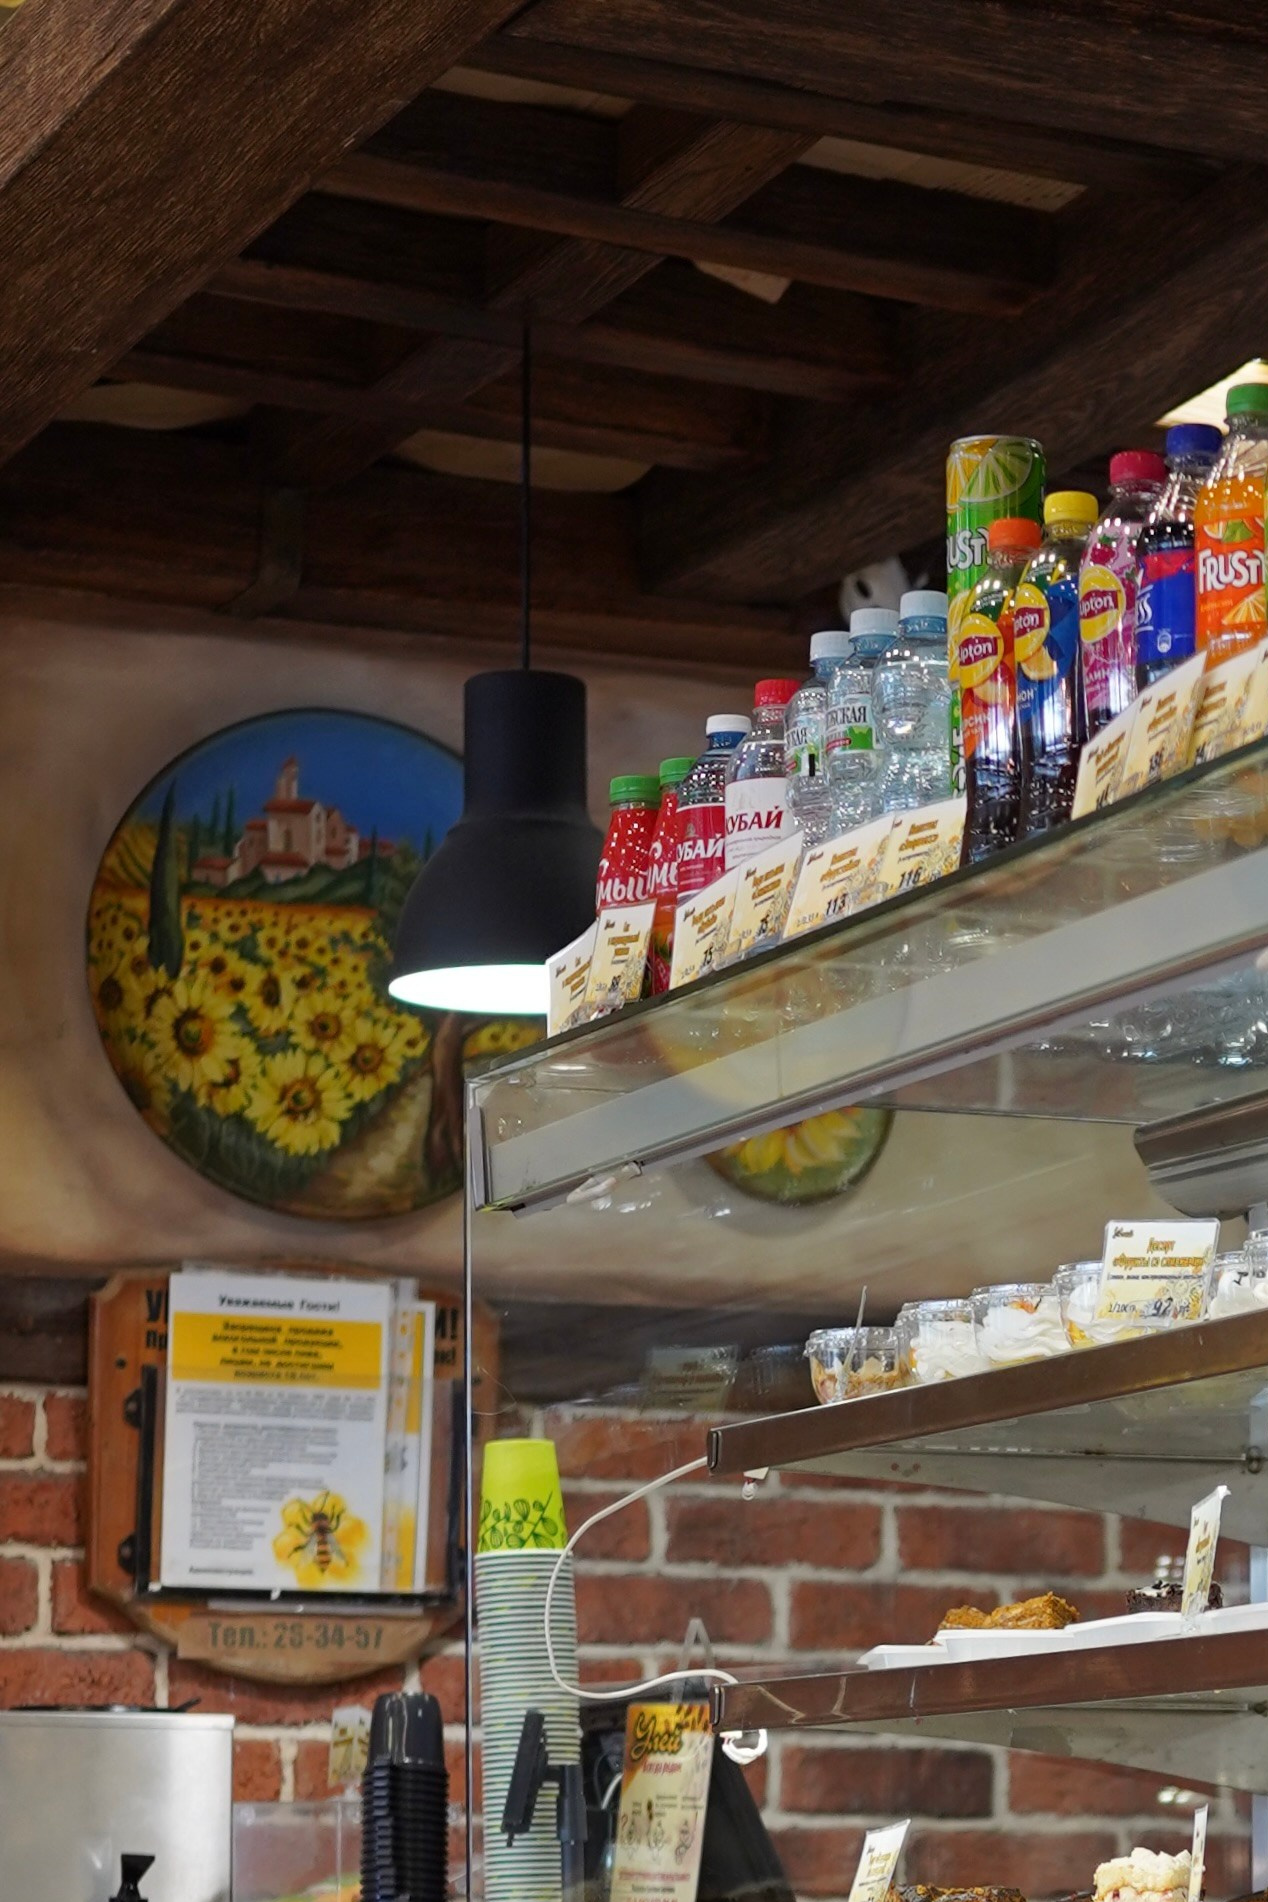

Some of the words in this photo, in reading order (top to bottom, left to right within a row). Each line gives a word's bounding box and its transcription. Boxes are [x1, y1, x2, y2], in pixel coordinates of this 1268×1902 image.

[959, 638, 994, 662] ipton
[676, 833, 725, 863] УБАЙ
[900, 866, 923, 889] 116
[826, 893, 848, 915] 113
[219, 1294, 294, 1309] Уважаемые
[299, 1300, 341, 1312] Гости!
[631, 1711, 684, 1762] Улей
